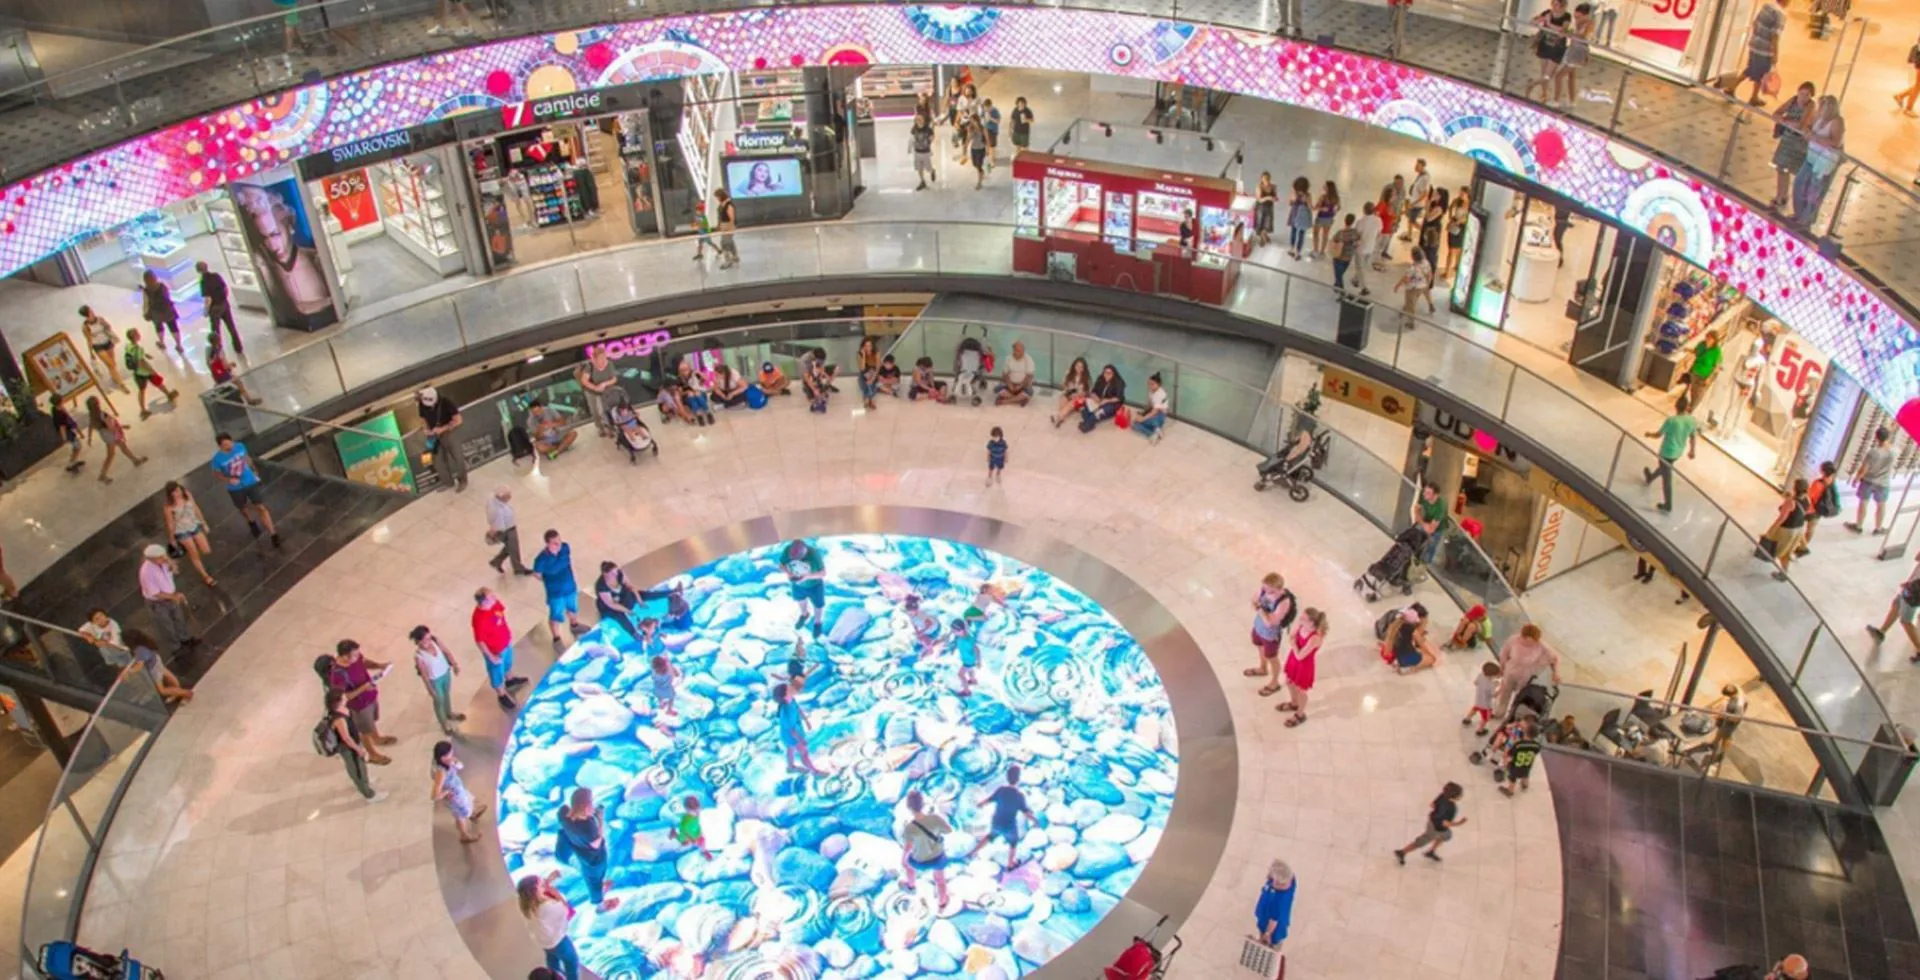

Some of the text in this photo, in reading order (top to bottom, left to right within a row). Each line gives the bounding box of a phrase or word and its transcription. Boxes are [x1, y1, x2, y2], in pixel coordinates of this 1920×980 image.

[505, 92, 600, 128] 7 camicie
[331, 131, 410, 162] SWAROVSKI
[330, 177, 366, 200] 50%
[1533, 510, 1563, 581] noodle
[1515, 751, 1535, 767] 99
